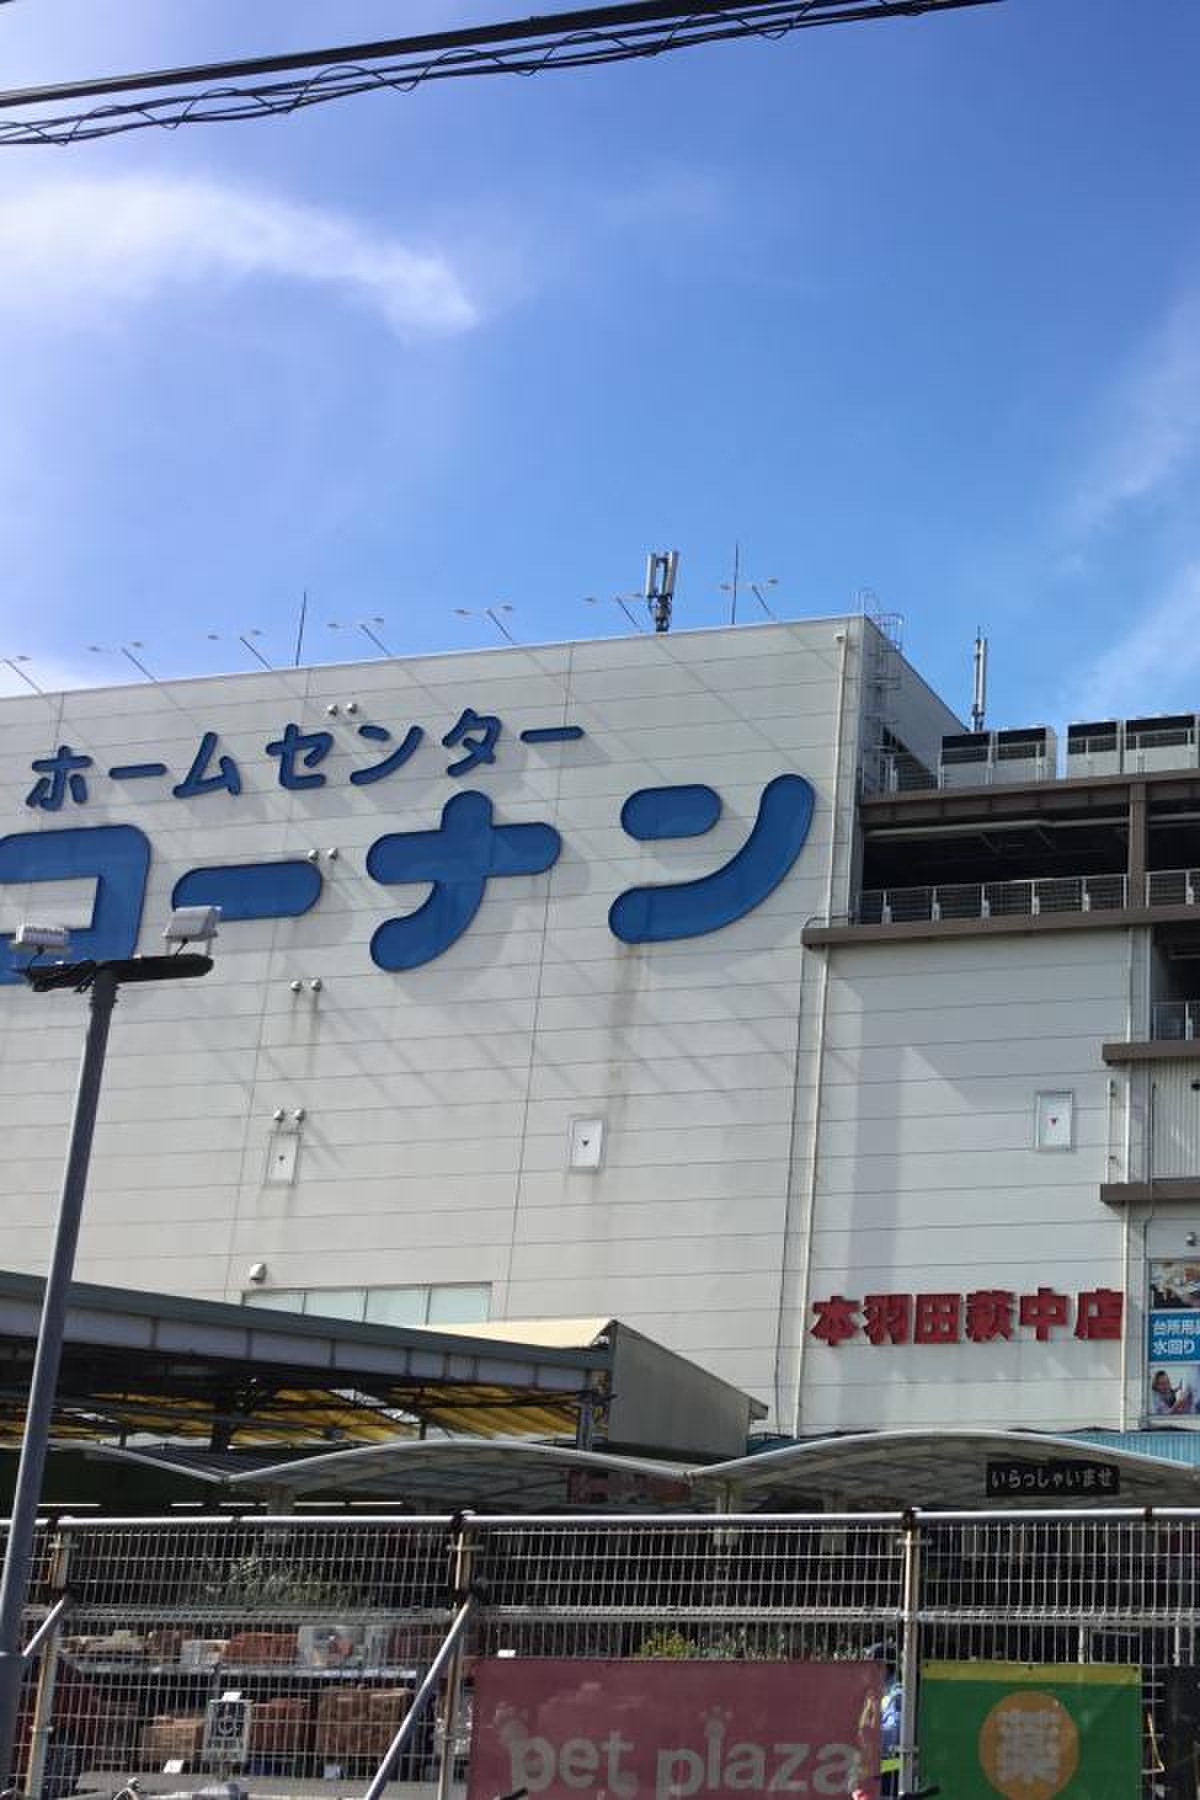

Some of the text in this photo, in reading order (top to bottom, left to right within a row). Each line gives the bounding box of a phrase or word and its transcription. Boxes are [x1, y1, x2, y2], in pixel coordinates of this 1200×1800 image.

[26, 708, 584, 812] ホームセンター
[0, 773, 816, 984] コーナン
[810, 1287, 1124, 1345] 本羽田萩中店
[991, 1467, 1116, 1489] いらっしゃいませ
[506, 1715, 862, 1799] pet plaza
